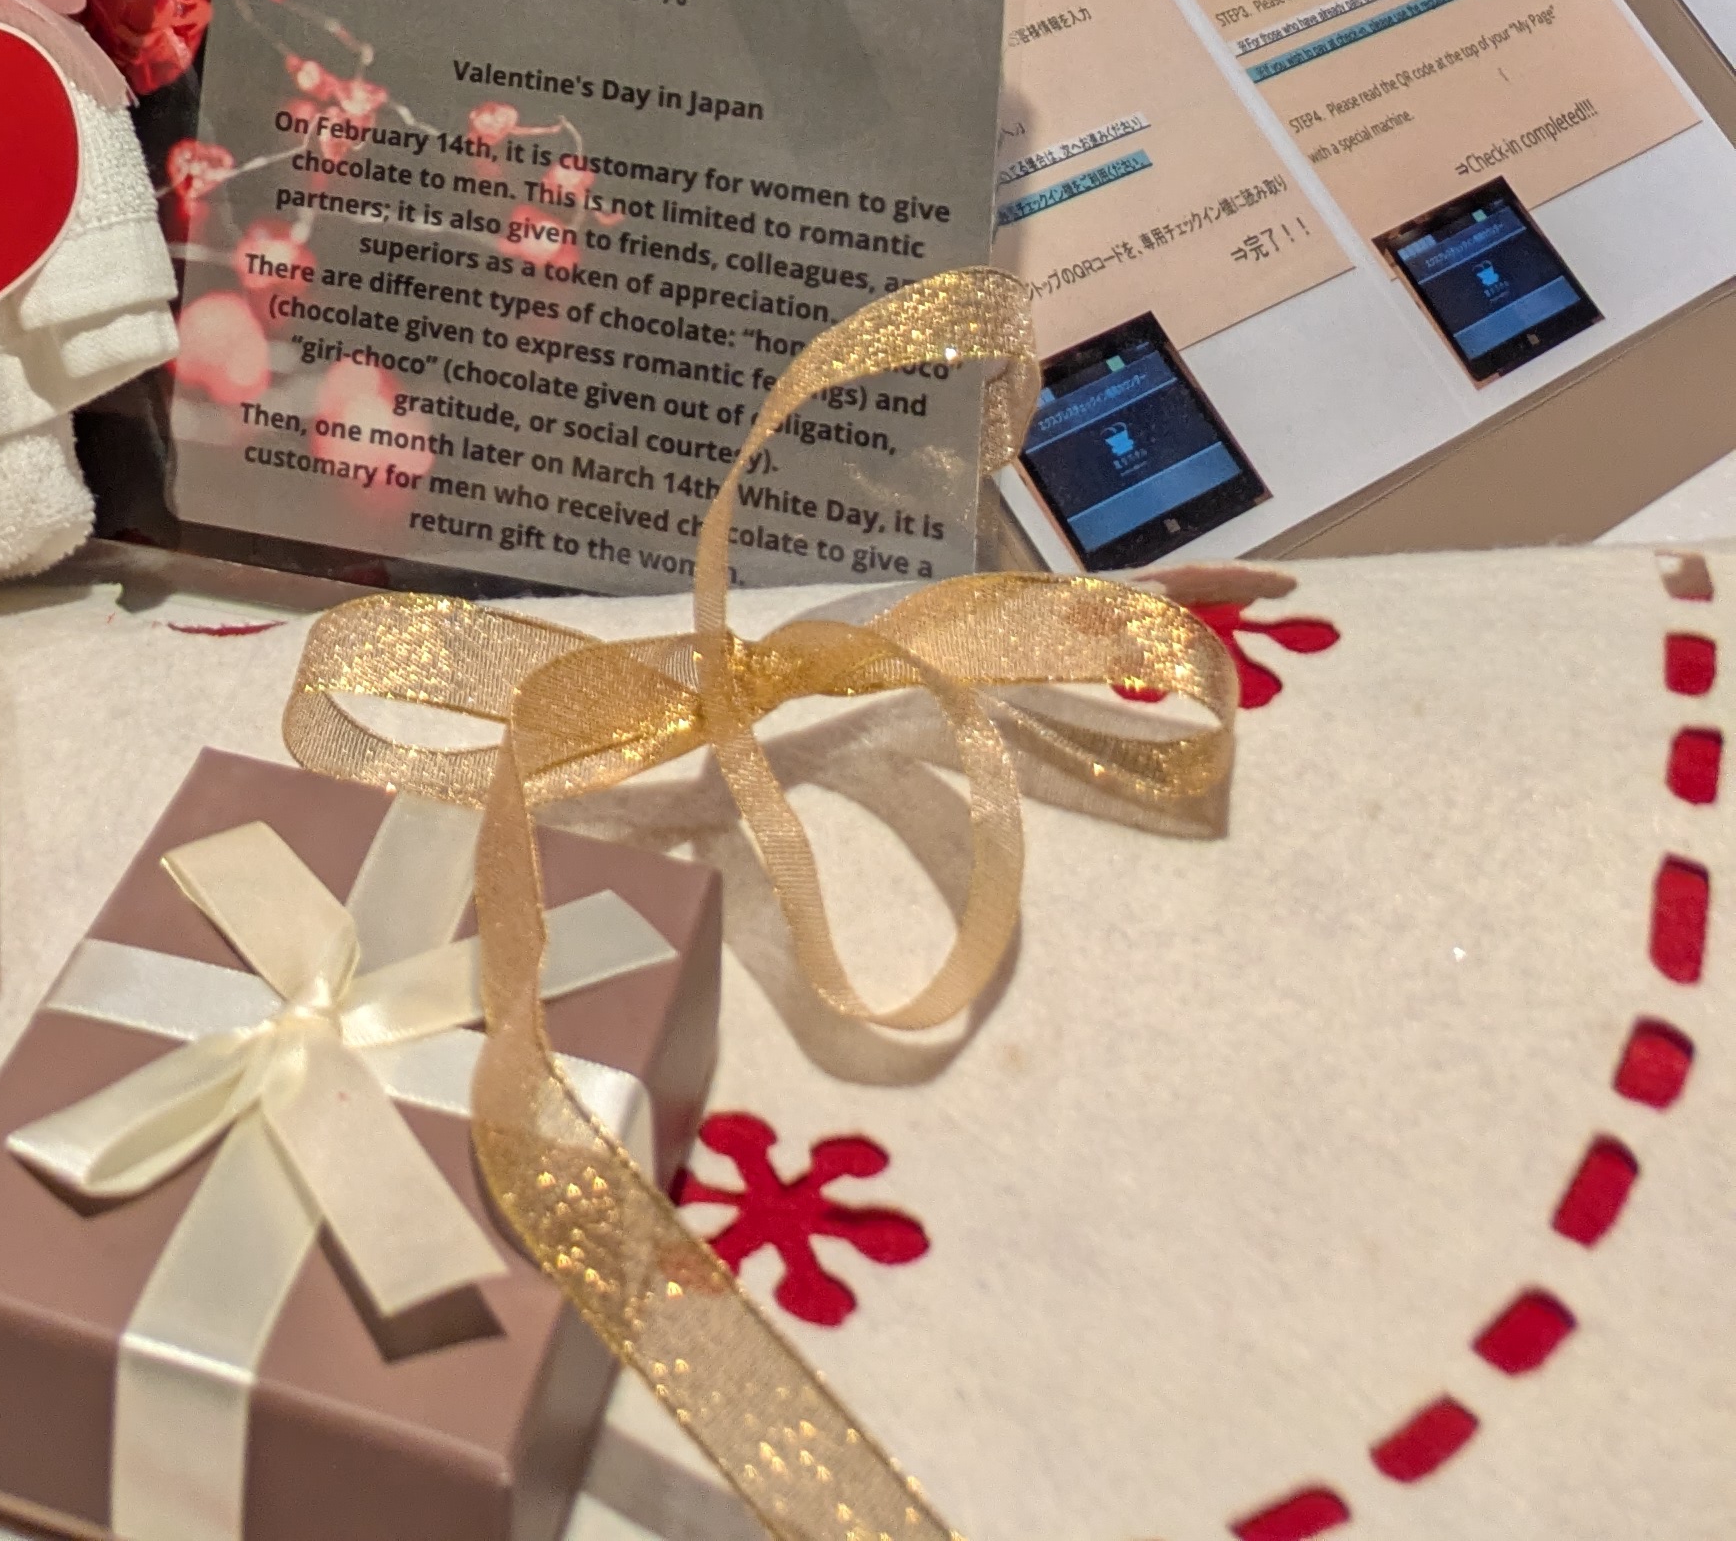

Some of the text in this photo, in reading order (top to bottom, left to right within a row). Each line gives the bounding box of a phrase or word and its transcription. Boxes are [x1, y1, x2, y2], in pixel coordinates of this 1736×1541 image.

[453, 60, 763, 120] Valentine's Day in Japan
[1519, 98, 1598, 148] completed!!!
[275, 110, 950, 223] On February 14th, it is customary for women to give
[1307, 110, 1413, 164] with a special machine.
[275, 188, 391, 220] partners;
[397, 200, 417, 223] it
[423, 203, 443, 226] is
[449, 208, 501, 234] also
[505, 217, 578, 246] given
[585, 229, 611, 251] to
[619, 232, 717, 270] friends,
[725, 251, 875, 292] colleagues,
[292, 150, 924, 259] chocolate to men. This is not limited to romantic
[246, 253, 735, 348] There are different types of chocolate:
[359, 237, 838, 326] superiors as a token of appreciation.
[269, 294, 399, 333] (chocolate
[404, 316, 474, 344] given
[482, 327, 509, 350] to
[515, 335, 615, 367] express
[623, 353, 744, 388] romantic
[875, 392, 927, 417] and
[443, 358, 579, 400] (chocolate
[584, 382, 656, 412] given
[663, 398, 709, 421] out
[716, 404, 745, 426] of
[393, 394, 520, 432] gratitude,
[529, 415, 557, 434] or
[563, 420, 639, 448] social
[241, 402, 308, 437] Then,
[314, 418, 361, 442] one
[370, 429, 455, 458] month
[462, 436, 525, 467] later
[531, 454, 563, 474] on
[572, 456, 654, 490] March
[737, 484, 818, 518] White
[826, 499, 885, 533] Day,
[895, 510, 915, 535] it
[923, 514, 944, 540] is
[244, 446, 377, 488] customary
[385, 464, 423, 490] for
[429, 476, 486, 501] men
[494, 484, 549, 512] who
[557, 498, 669, 532] received
[817, 540, 845, 562] to
[851, 546, 909, 575] give
[917, 560, 933, 579] a
[409, 512, 493, 541] return
[499, 523, 545, 550] gift
[553, 533, 580, 556] to
[587, 537, 631, 565] the
